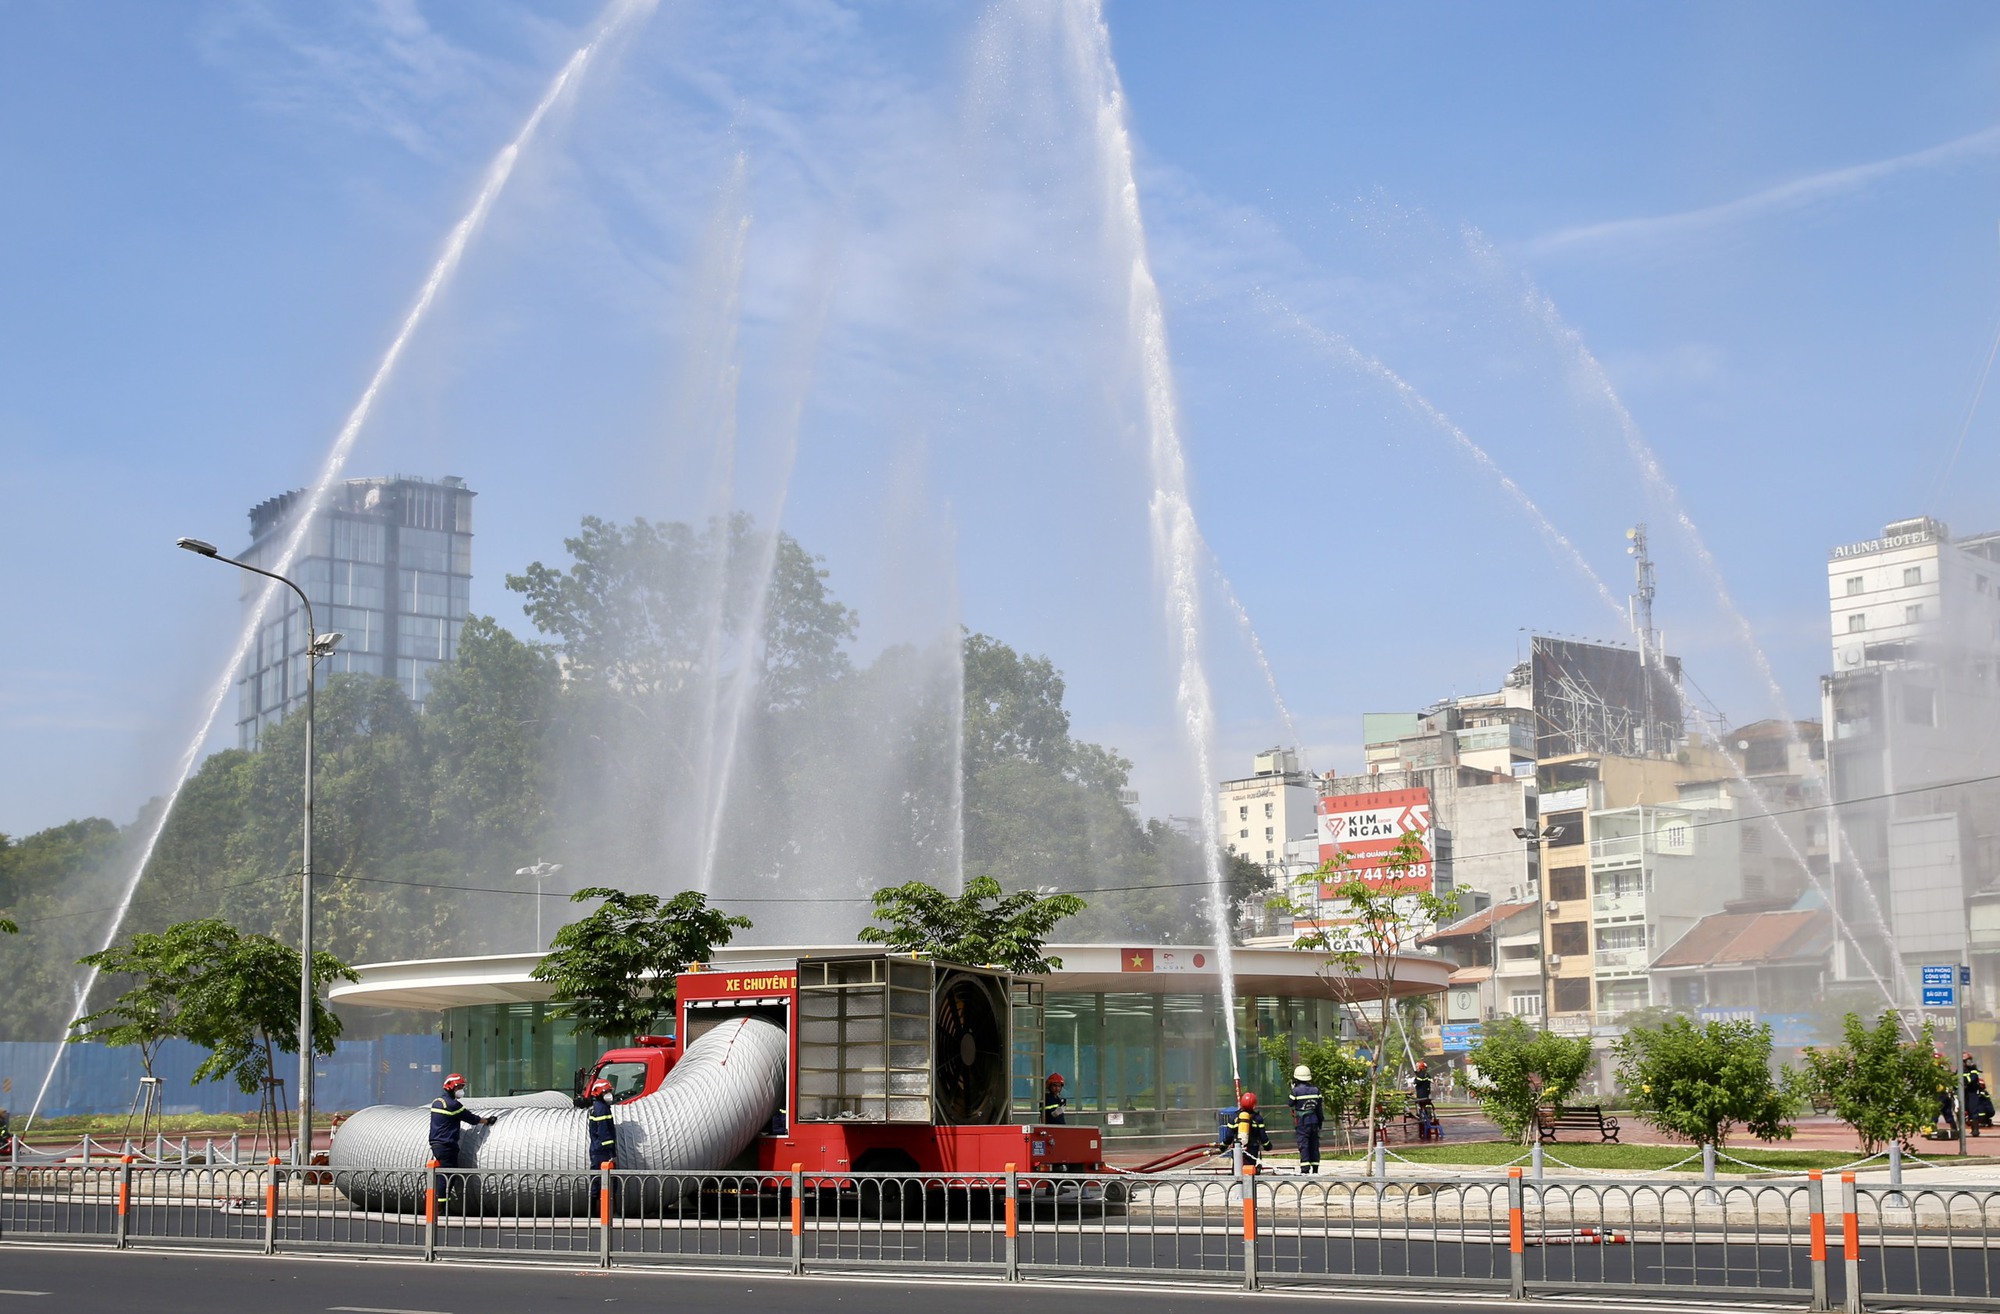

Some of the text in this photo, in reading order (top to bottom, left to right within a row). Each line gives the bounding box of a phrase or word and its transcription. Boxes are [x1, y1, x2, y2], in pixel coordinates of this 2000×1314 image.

[1835, 531, 1930, 558] ALUNA HOTEL
[1348, 814, 1377, 827] KIM
[1349, 824, 1392, 837] NGAN
[1408, 863, 1427, 879] 88
[726, 979, 741, 991] XE
[743, 974, 788, 991] CHUYÊN
